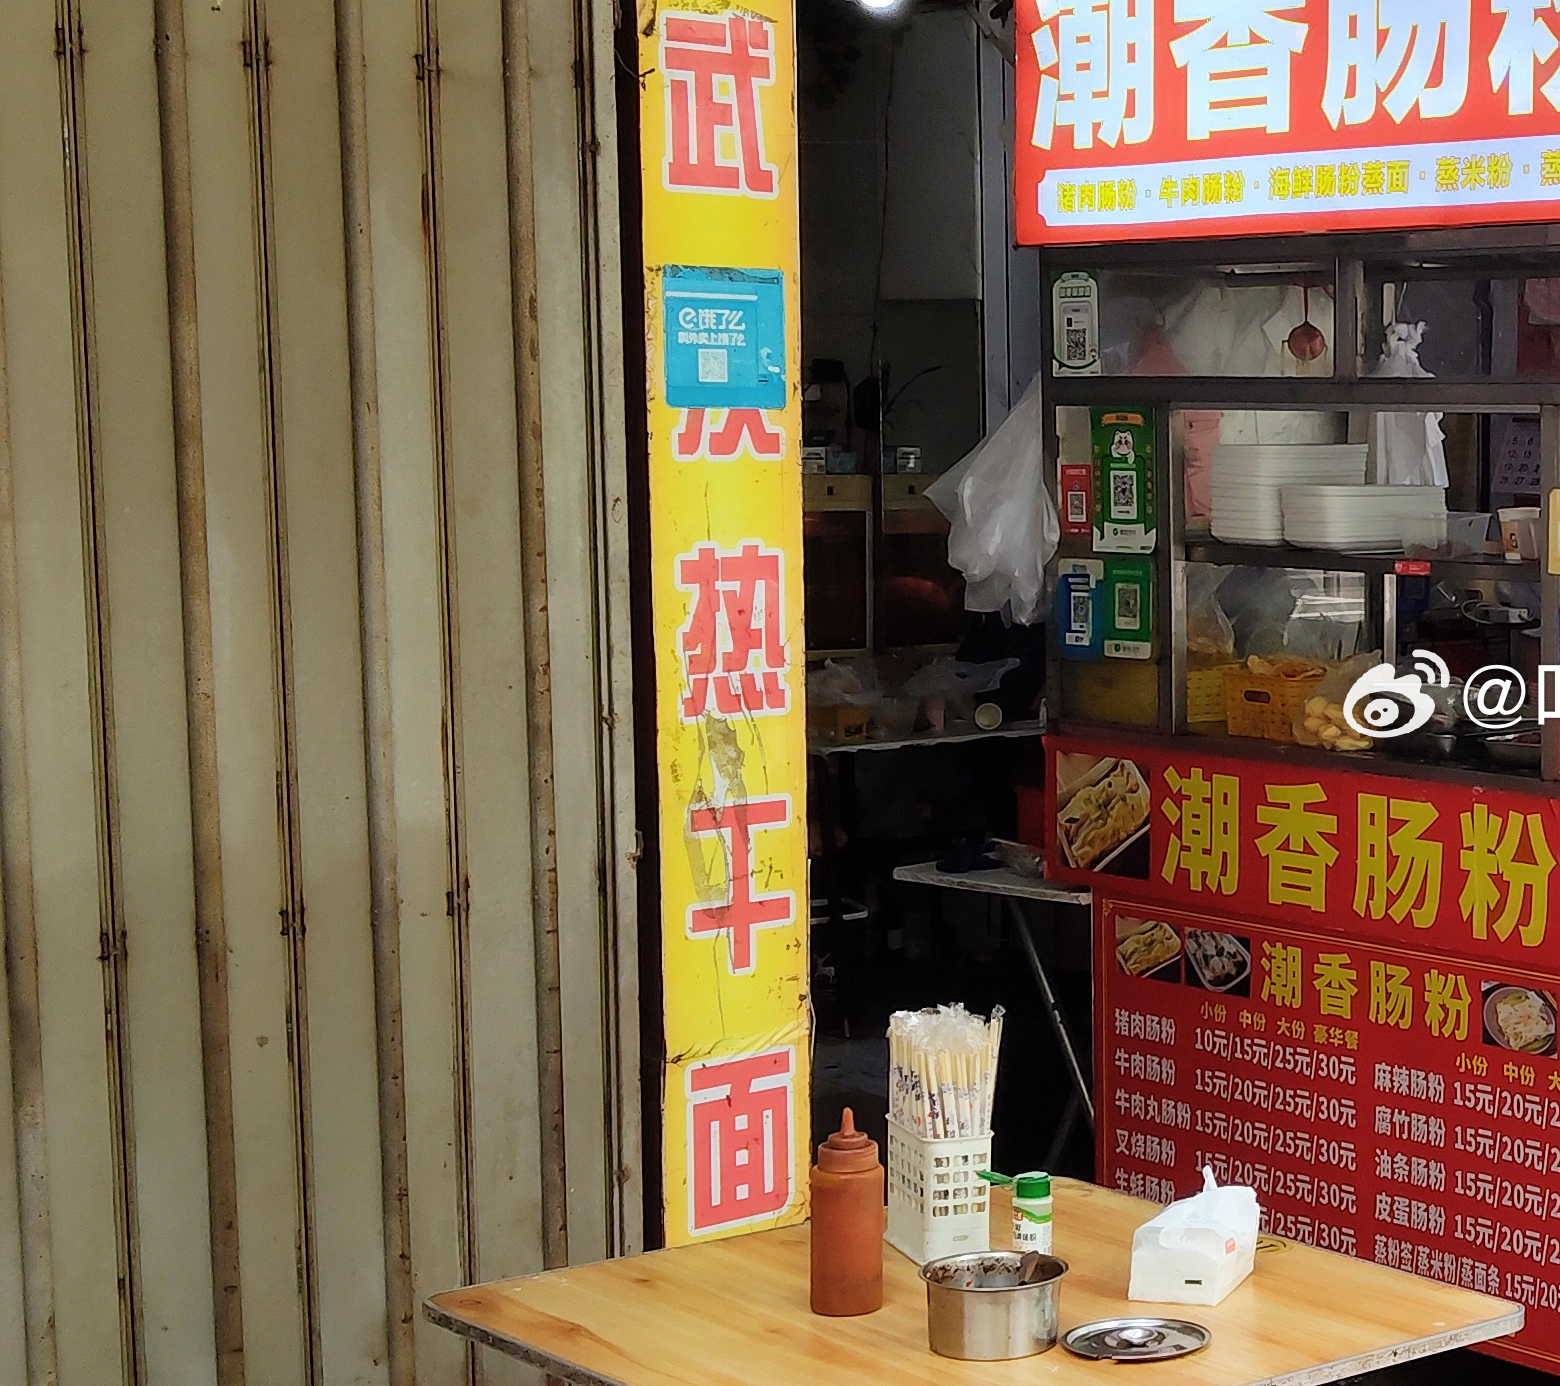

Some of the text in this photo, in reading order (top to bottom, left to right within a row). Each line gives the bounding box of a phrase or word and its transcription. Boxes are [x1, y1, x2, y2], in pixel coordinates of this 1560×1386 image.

[1160, 764, 1557, 947] 潮香肠粉
[1258, 939, 1472, 1043] 潮香肠粉
